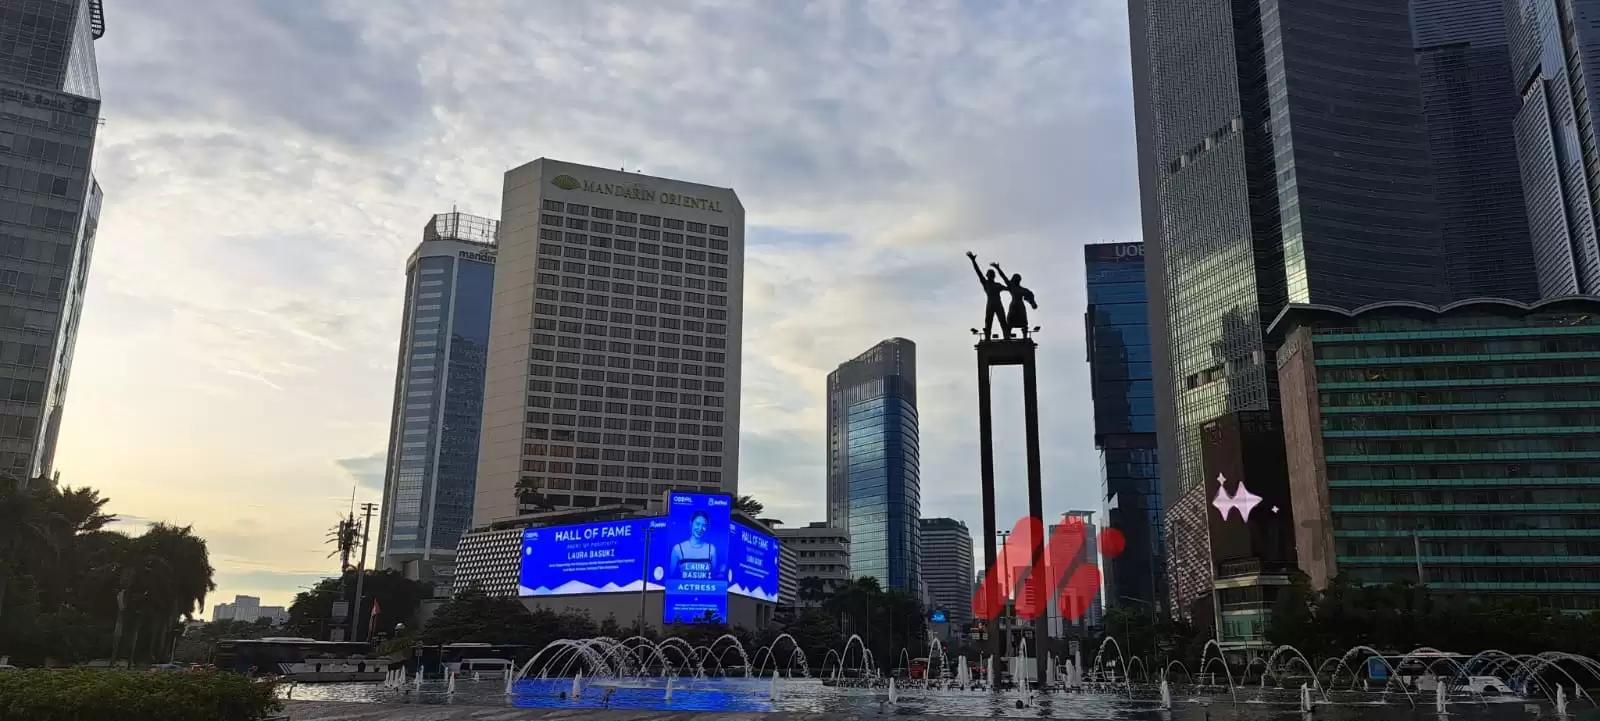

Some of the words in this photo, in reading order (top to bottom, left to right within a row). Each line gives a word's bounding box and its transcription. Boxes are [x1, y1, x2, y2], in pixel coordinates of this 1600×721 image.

[583, 179, 656, 201] MANDARIN
[659, 192, 723, 213] ORIENTAL
[555, 529, 582, 542] HALL
[584, 527, 599, 540] OF
[601, 525, 632, 538] FAME
[567, 551, 588, 560] LAURA
[589, 548, 615, 559] BASUKI
[685, 563, 711, 571] LAURA
[682, 571, 712, 579] BASUKI
[678, 583, 716, 592] ACTRESS
